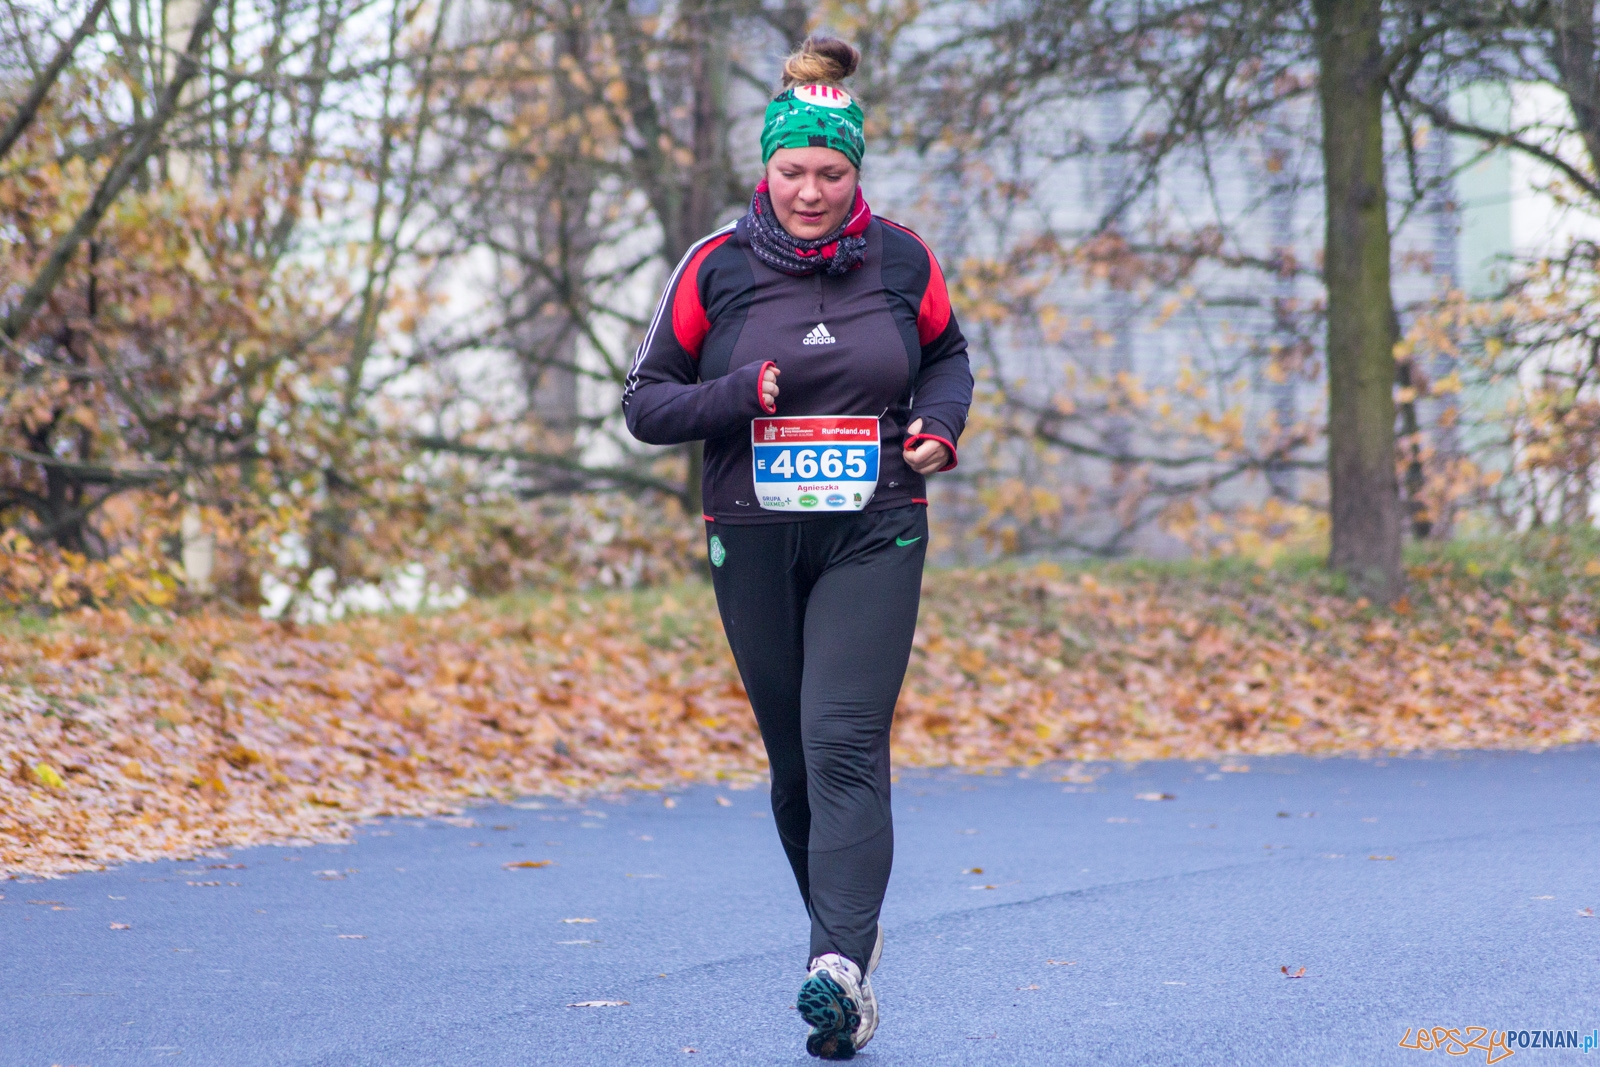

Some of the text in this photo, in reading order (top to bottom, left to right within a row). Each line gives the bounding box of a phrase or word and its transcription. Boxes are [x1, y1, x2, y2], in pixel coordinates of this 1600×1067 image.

[803, 336, 836, 345] adidas
[821, 427, 871, 437] RunPoland.org
[757, 448, 867, 479] E 4665
[797, 484, 839, 493] Agnieszka
